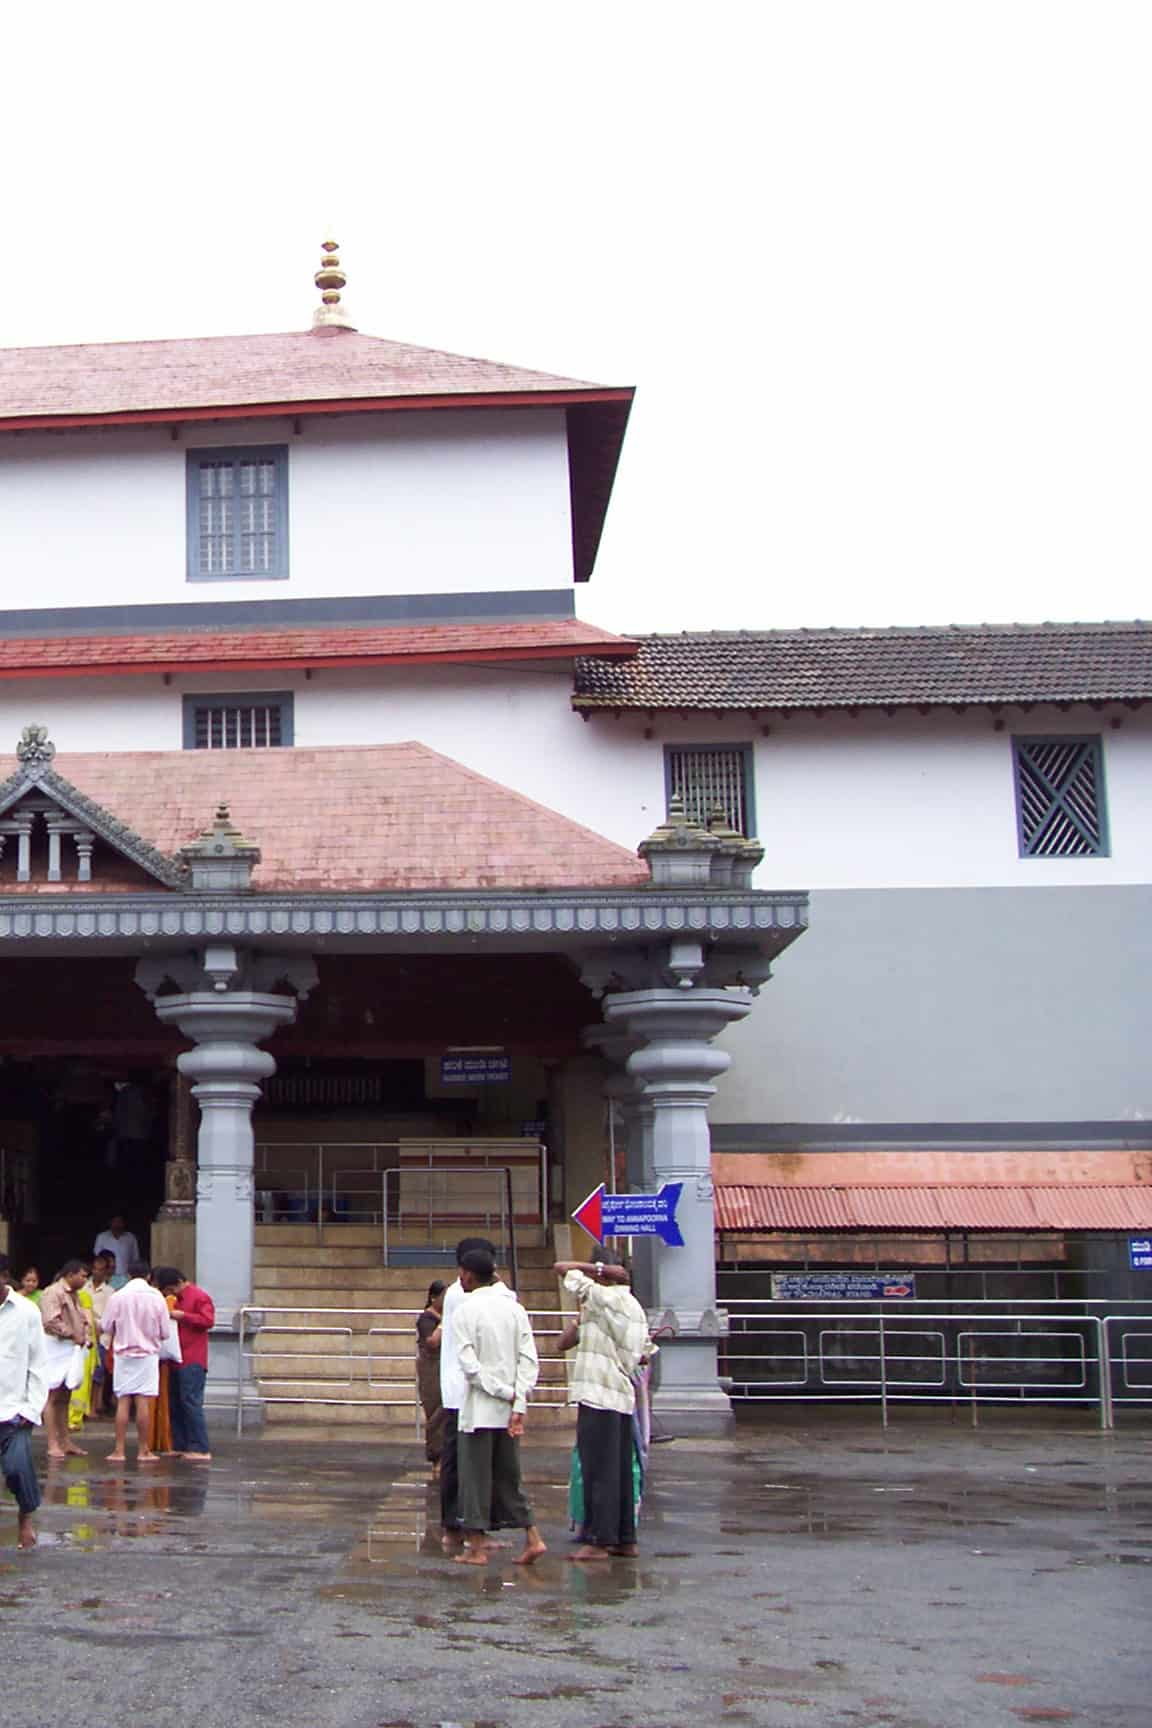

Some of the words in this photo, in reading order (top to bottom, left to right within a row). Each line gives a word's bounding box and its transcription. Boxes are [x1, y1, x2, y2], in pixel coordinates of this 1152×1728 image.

[617, 1215, 625, 1223] TO
[614, 1224, 640, 1233] DINING
[640, 1224, 656, 1233] HALL
